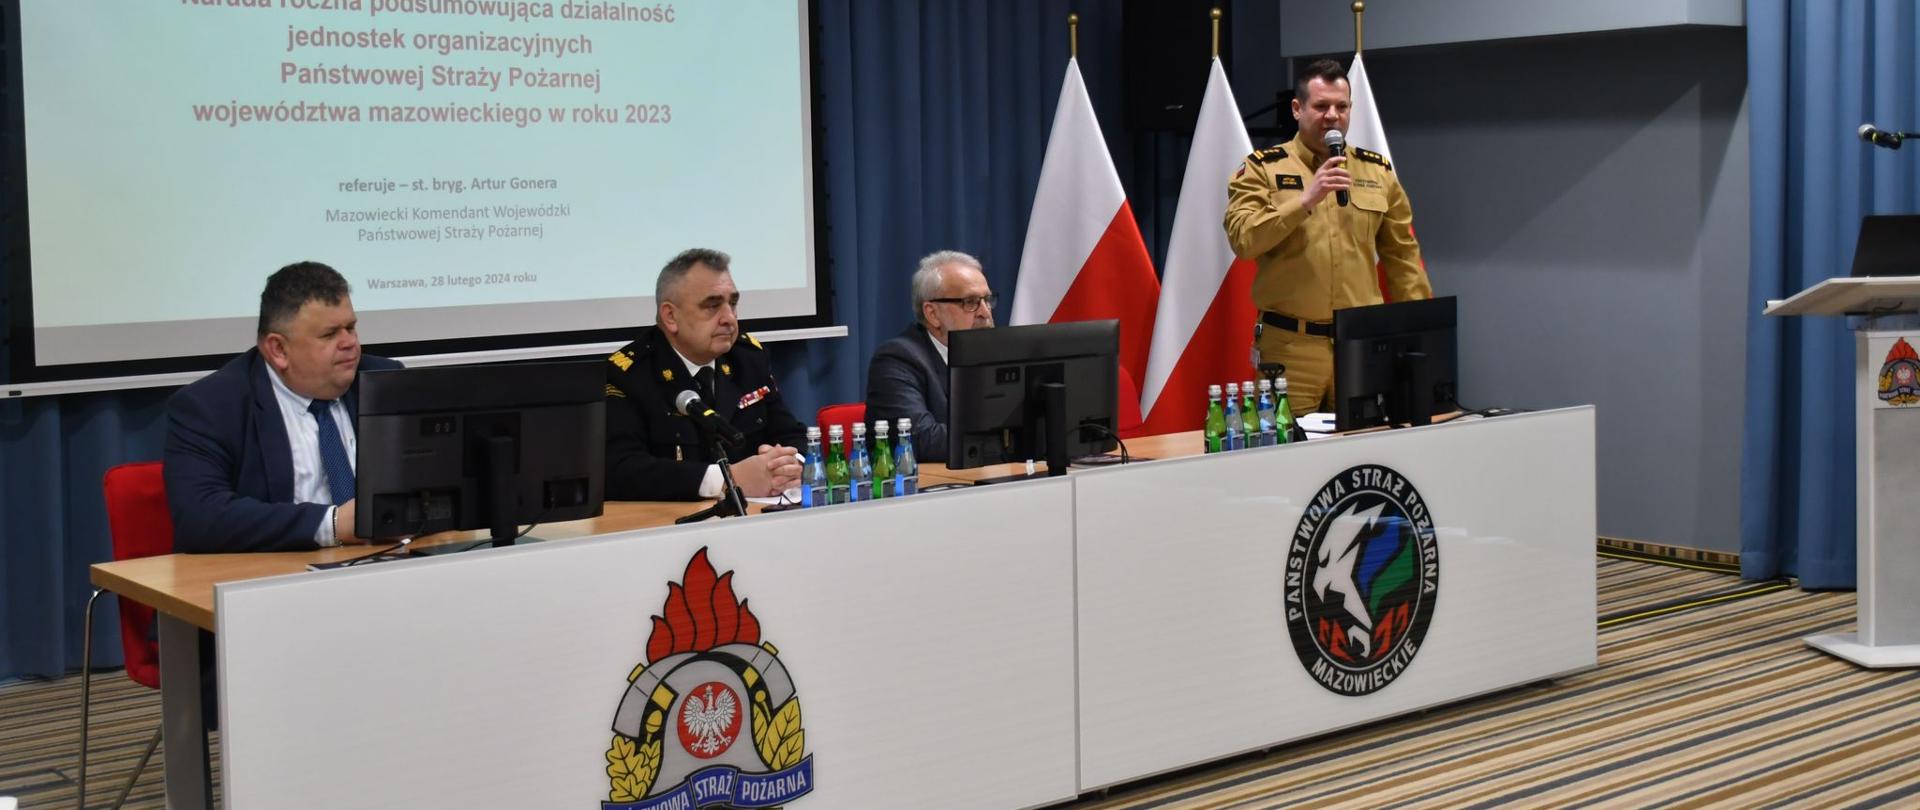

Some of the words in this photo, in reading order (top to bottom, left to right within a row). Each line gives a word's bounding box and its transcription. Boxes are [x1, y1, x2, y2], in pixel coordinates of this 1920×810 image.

[370, 0, 553, 22] podsumowująca
[560, 0, 675, 23] działalność
[287, 25, 406, 52] jednostek
[413, 31, 592, 58] organizacyjnych
[281, 62, 423, 91] Państwowej
[432, 65, 501, 92] Straży
[509, 67, 600, 94] Pożarnej
[192, 100, 360, 127] województwa
[369, 102, 542, 128] mazowieckiego
[548, 108, 565, 123] w
[572, 104, 618, 123] roku
[625, 104, 671, 124] 2023
[339, 178, 395, 195] referuje
[412, 179, 428, 191] st.
[433, 177, 468, 194] bryg.
[471, 178, 506, 190] Artur
[510, 177, 557, 189] Gonera
[326, 207, 408, 222] Mazowiecki
[413, 205, 489, 221] Komendant
[493, 204, 570, 221] Wojewódzki
[358, 226, 440, 242] Państwowej
[445, 224, 485, 240] Straży
[488, 224, 543, 239] Pożarnej
[367, 279, 428, 289] Warszawa,
[431, 276, 445, 287] 28
[447, 275, 482, 287] lutego
[484, 273, 511, 284] 2024
[512, 272, 537, 283] roku
[1286, 480, 1346, 621] PAŃSTWOWA
[1311, 637, 1417, 693] MAZOWIECKIE
[695, 772, 733, 801] STRAŻ
[742, 773, 806, 801] POŻARNA
